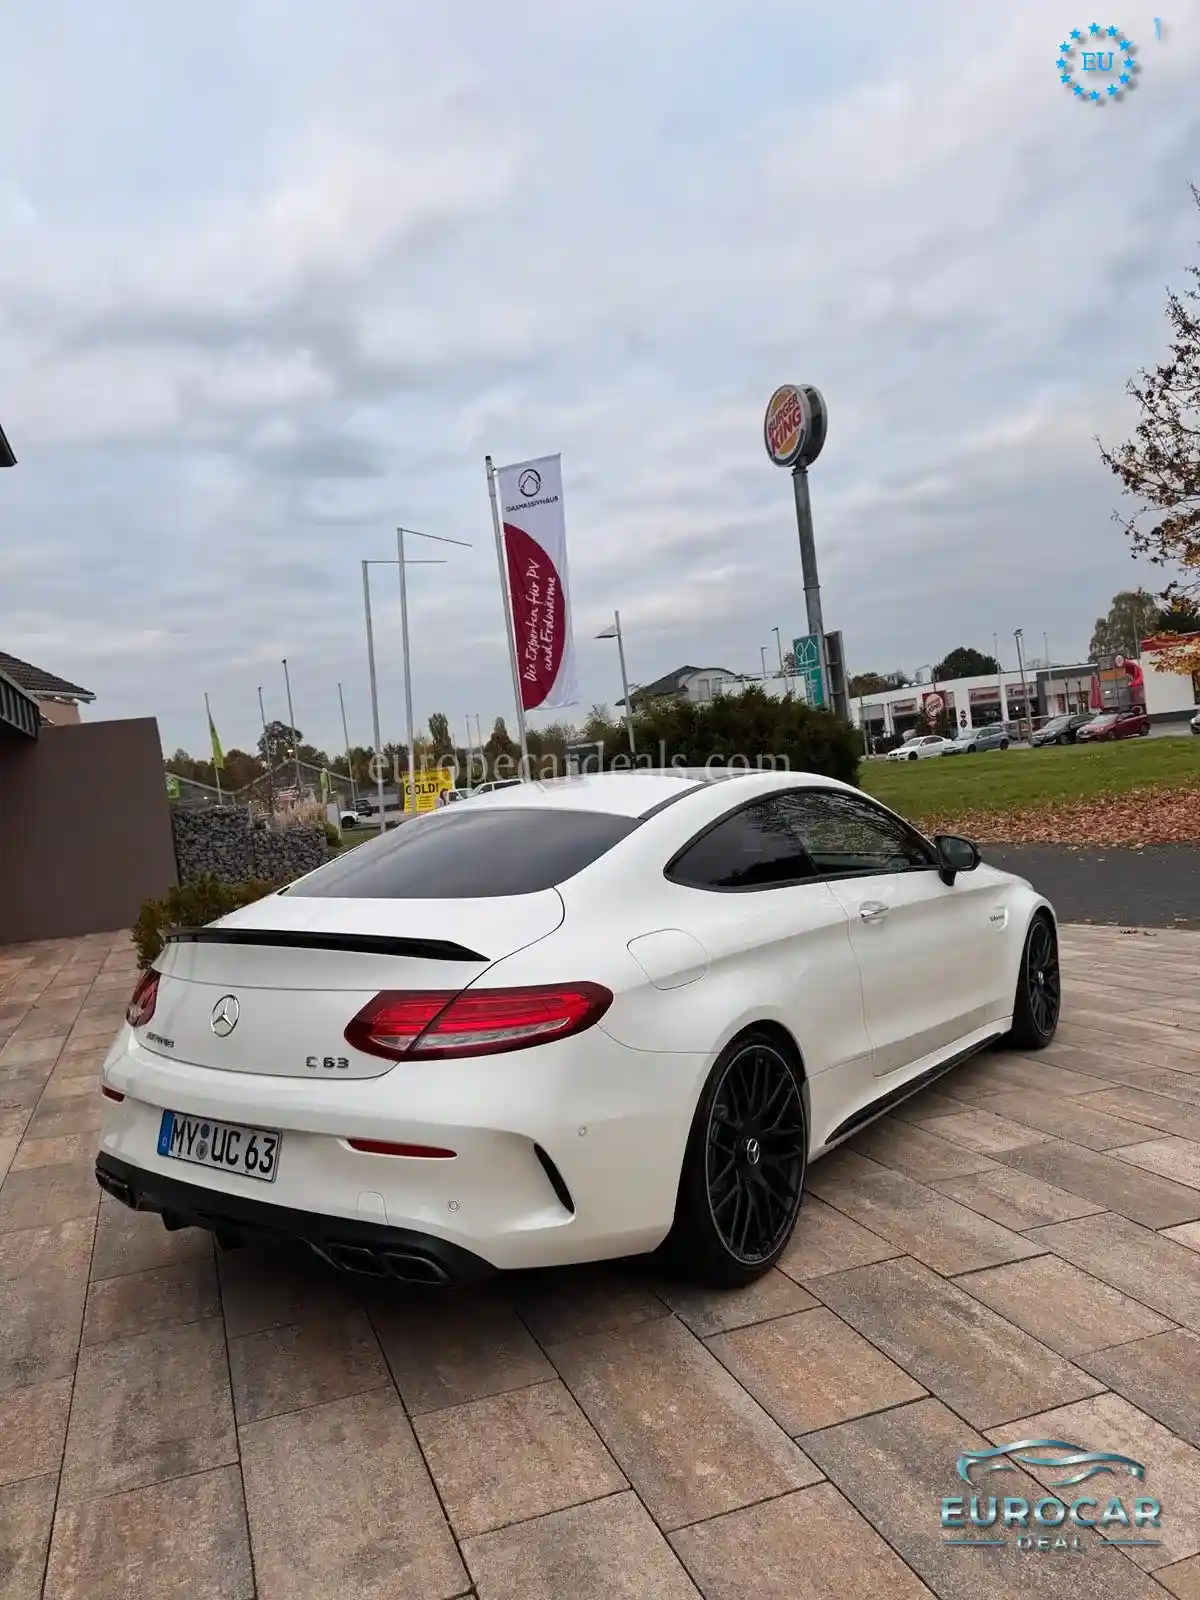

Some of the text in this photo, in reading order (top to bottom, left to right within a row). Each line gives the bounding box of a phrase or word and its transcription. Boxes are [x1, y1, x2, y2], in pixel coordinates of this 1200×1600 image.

[768, 392, 801, 440] BURGER
[771, 405, 802, 457] KING
[523, 557, 543, 682] Die Experten für PV
[540, 577, 556, 671] und Erdwärme
[306, 1056, 350, 1069] C 63
[170, 1117, 277, 1174] MY UC 63
